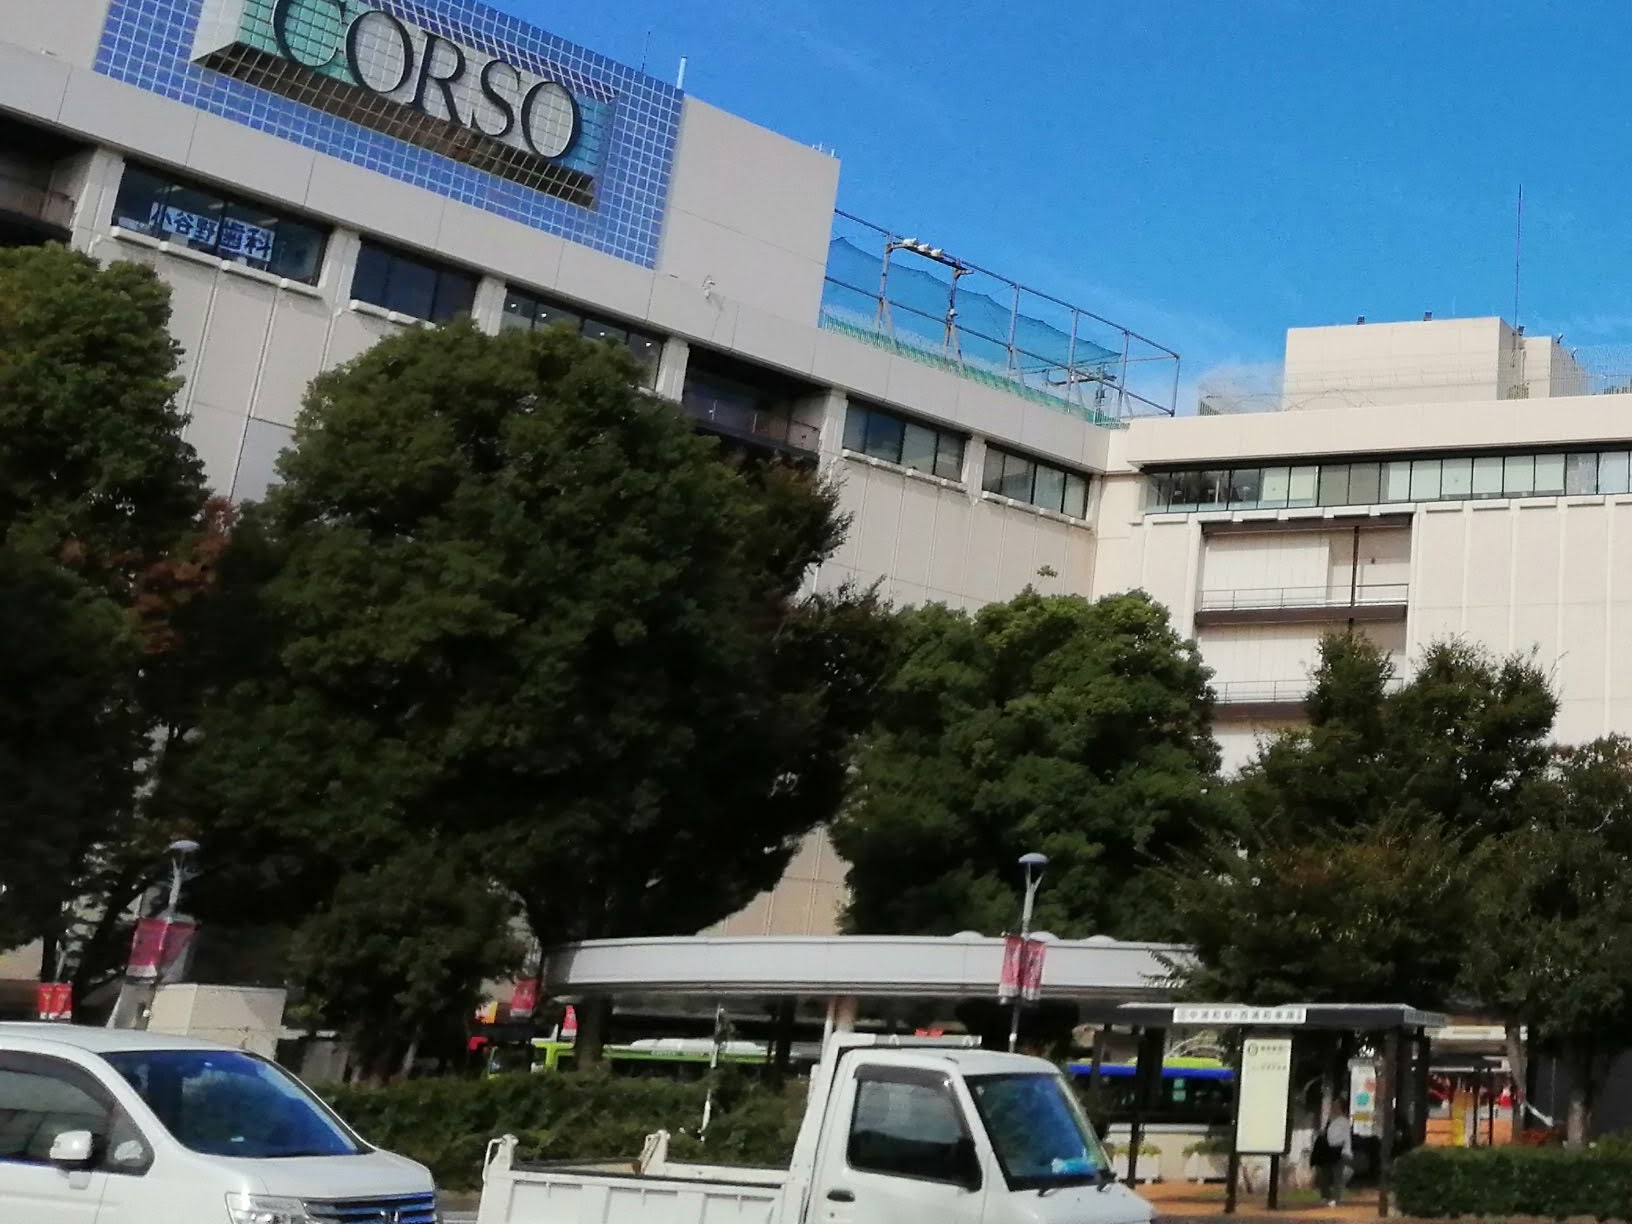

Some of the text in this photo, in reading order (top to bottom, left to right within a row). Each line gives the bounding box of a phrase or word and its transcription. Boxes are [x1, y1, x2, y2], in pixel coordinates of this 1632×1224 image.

[150, 202, 272, 259] 小谷野歯科
